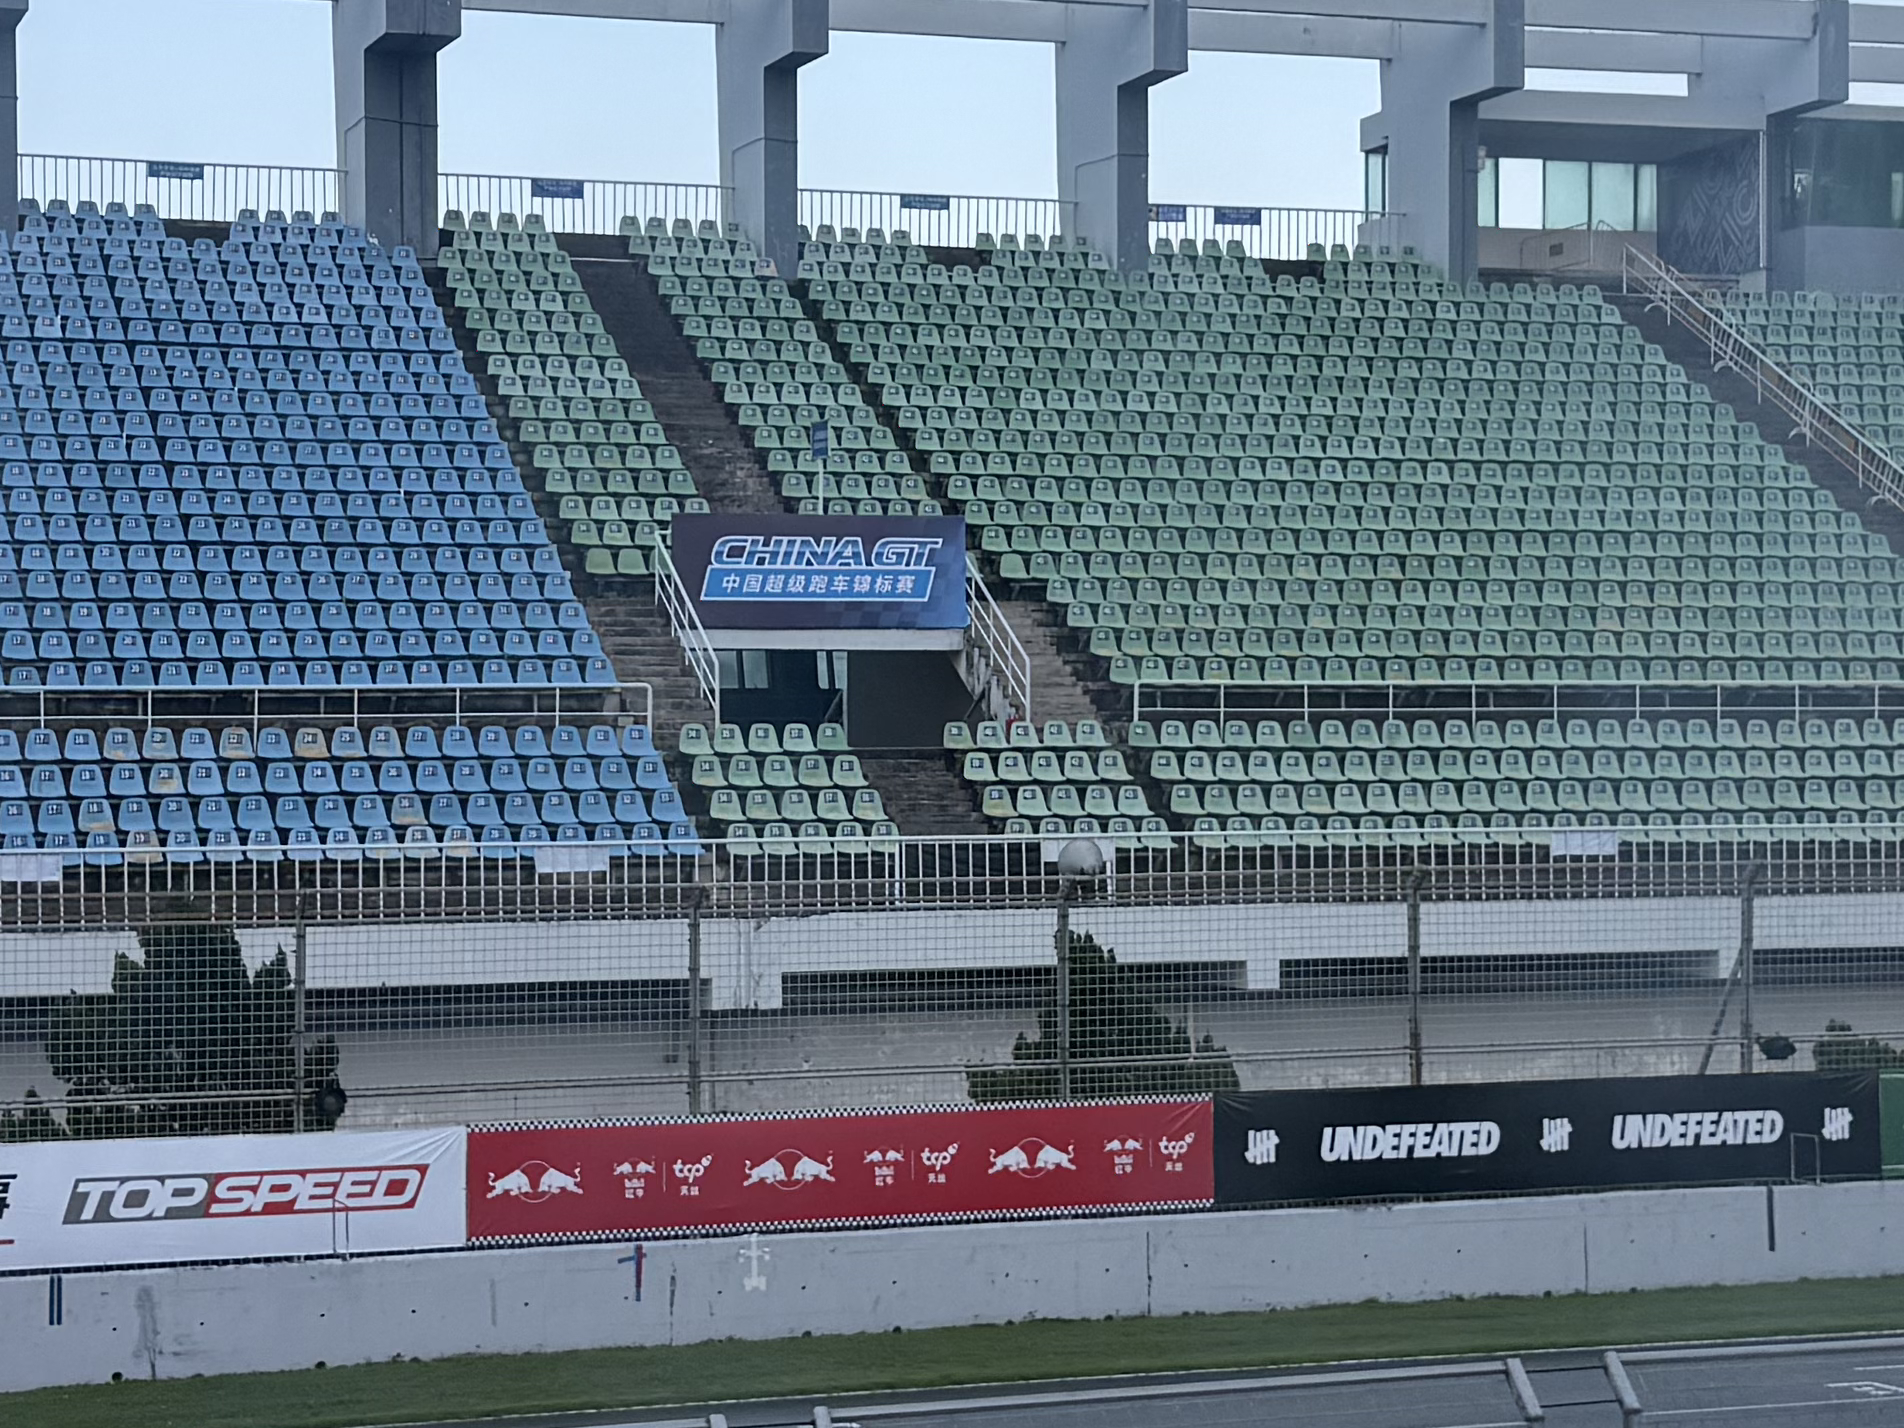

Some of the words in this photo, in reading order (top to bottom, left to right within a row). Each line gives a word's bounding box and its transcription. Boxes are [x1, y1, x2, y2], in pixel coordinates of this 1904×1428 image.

[710, 535, 867, 568] CHINA
[871, 537, 944, 569] GT
[721, 572, 917, 595] 中国超级跑车锦标赛
[1319, 1120, 1501, 1163] UNDEFEATED
[1610, 1109, 1785, 1151] UNDEFEATED
